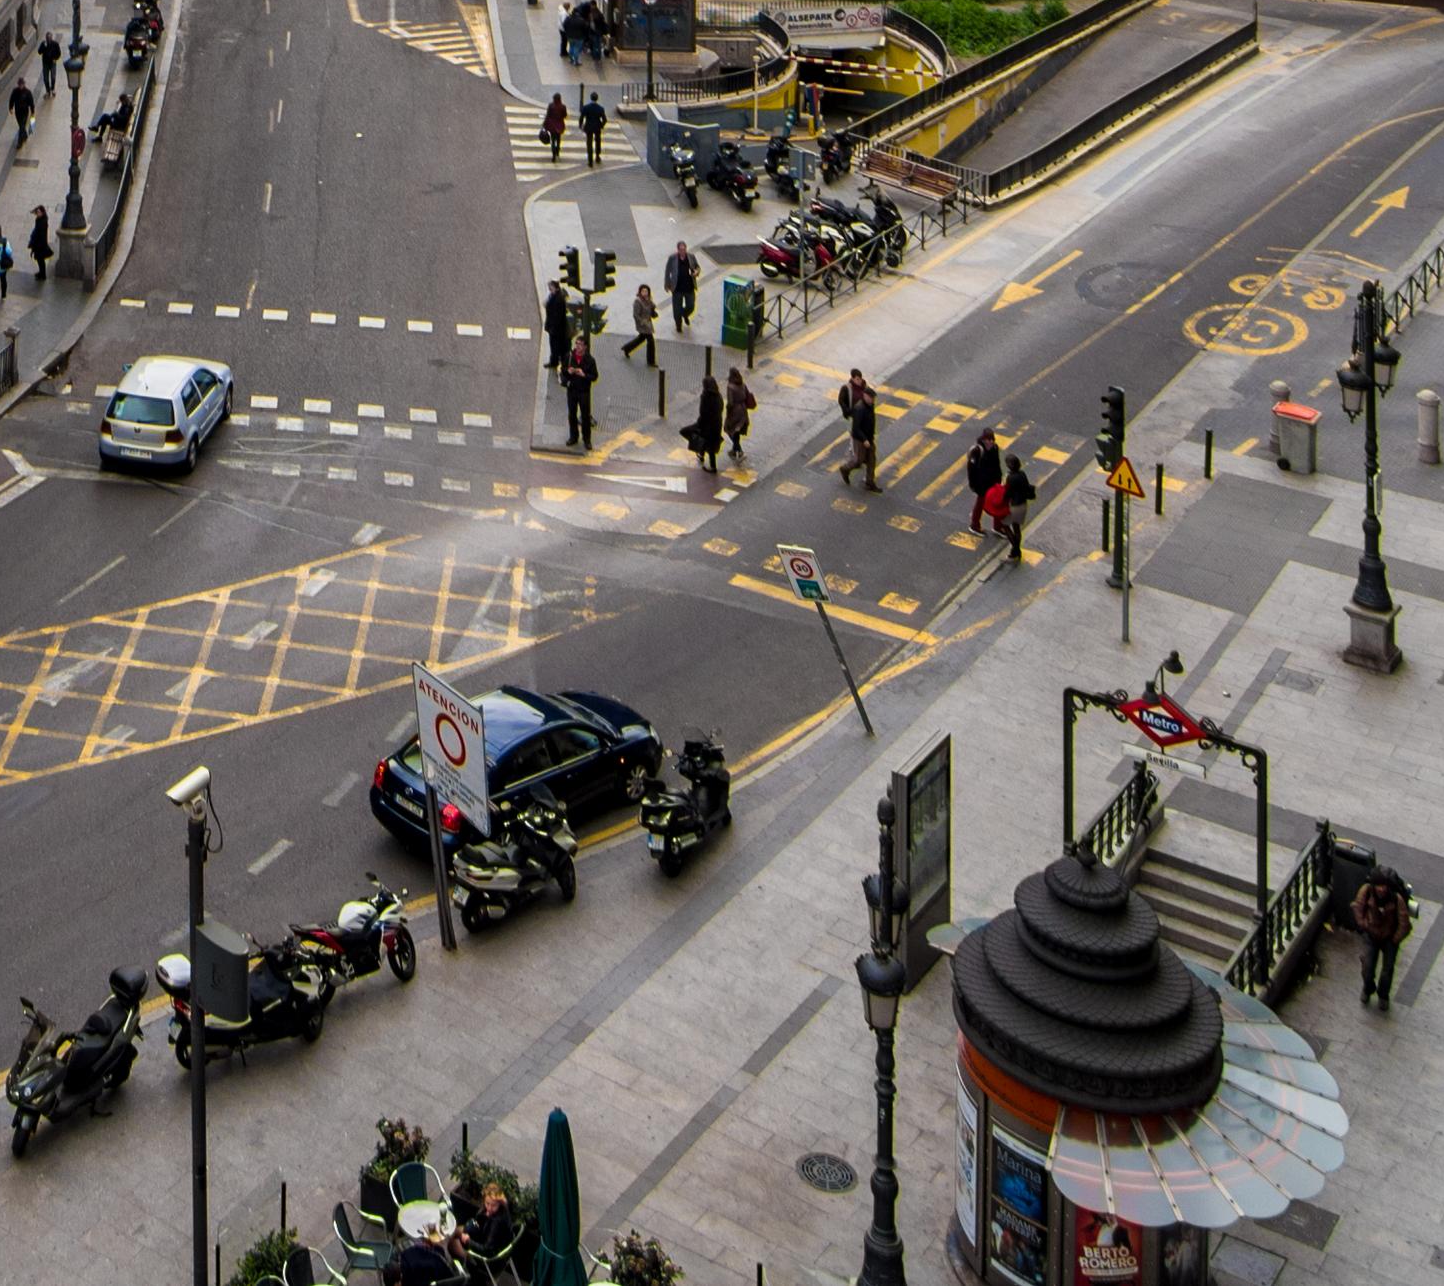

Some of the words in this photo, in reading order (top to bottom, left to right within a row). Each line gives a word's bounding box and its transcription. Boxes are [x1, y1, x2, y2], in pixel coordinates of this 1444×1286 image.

[788, 12, 833, 23] ALSEPARK
[1141, 710, 1180, 733] Metro
[996, 1145, 1043, 1186] Marina
[1083, 1244, 1130, 1259] BERTO
[1079, 1256, 1137, 1269] ROMERO
